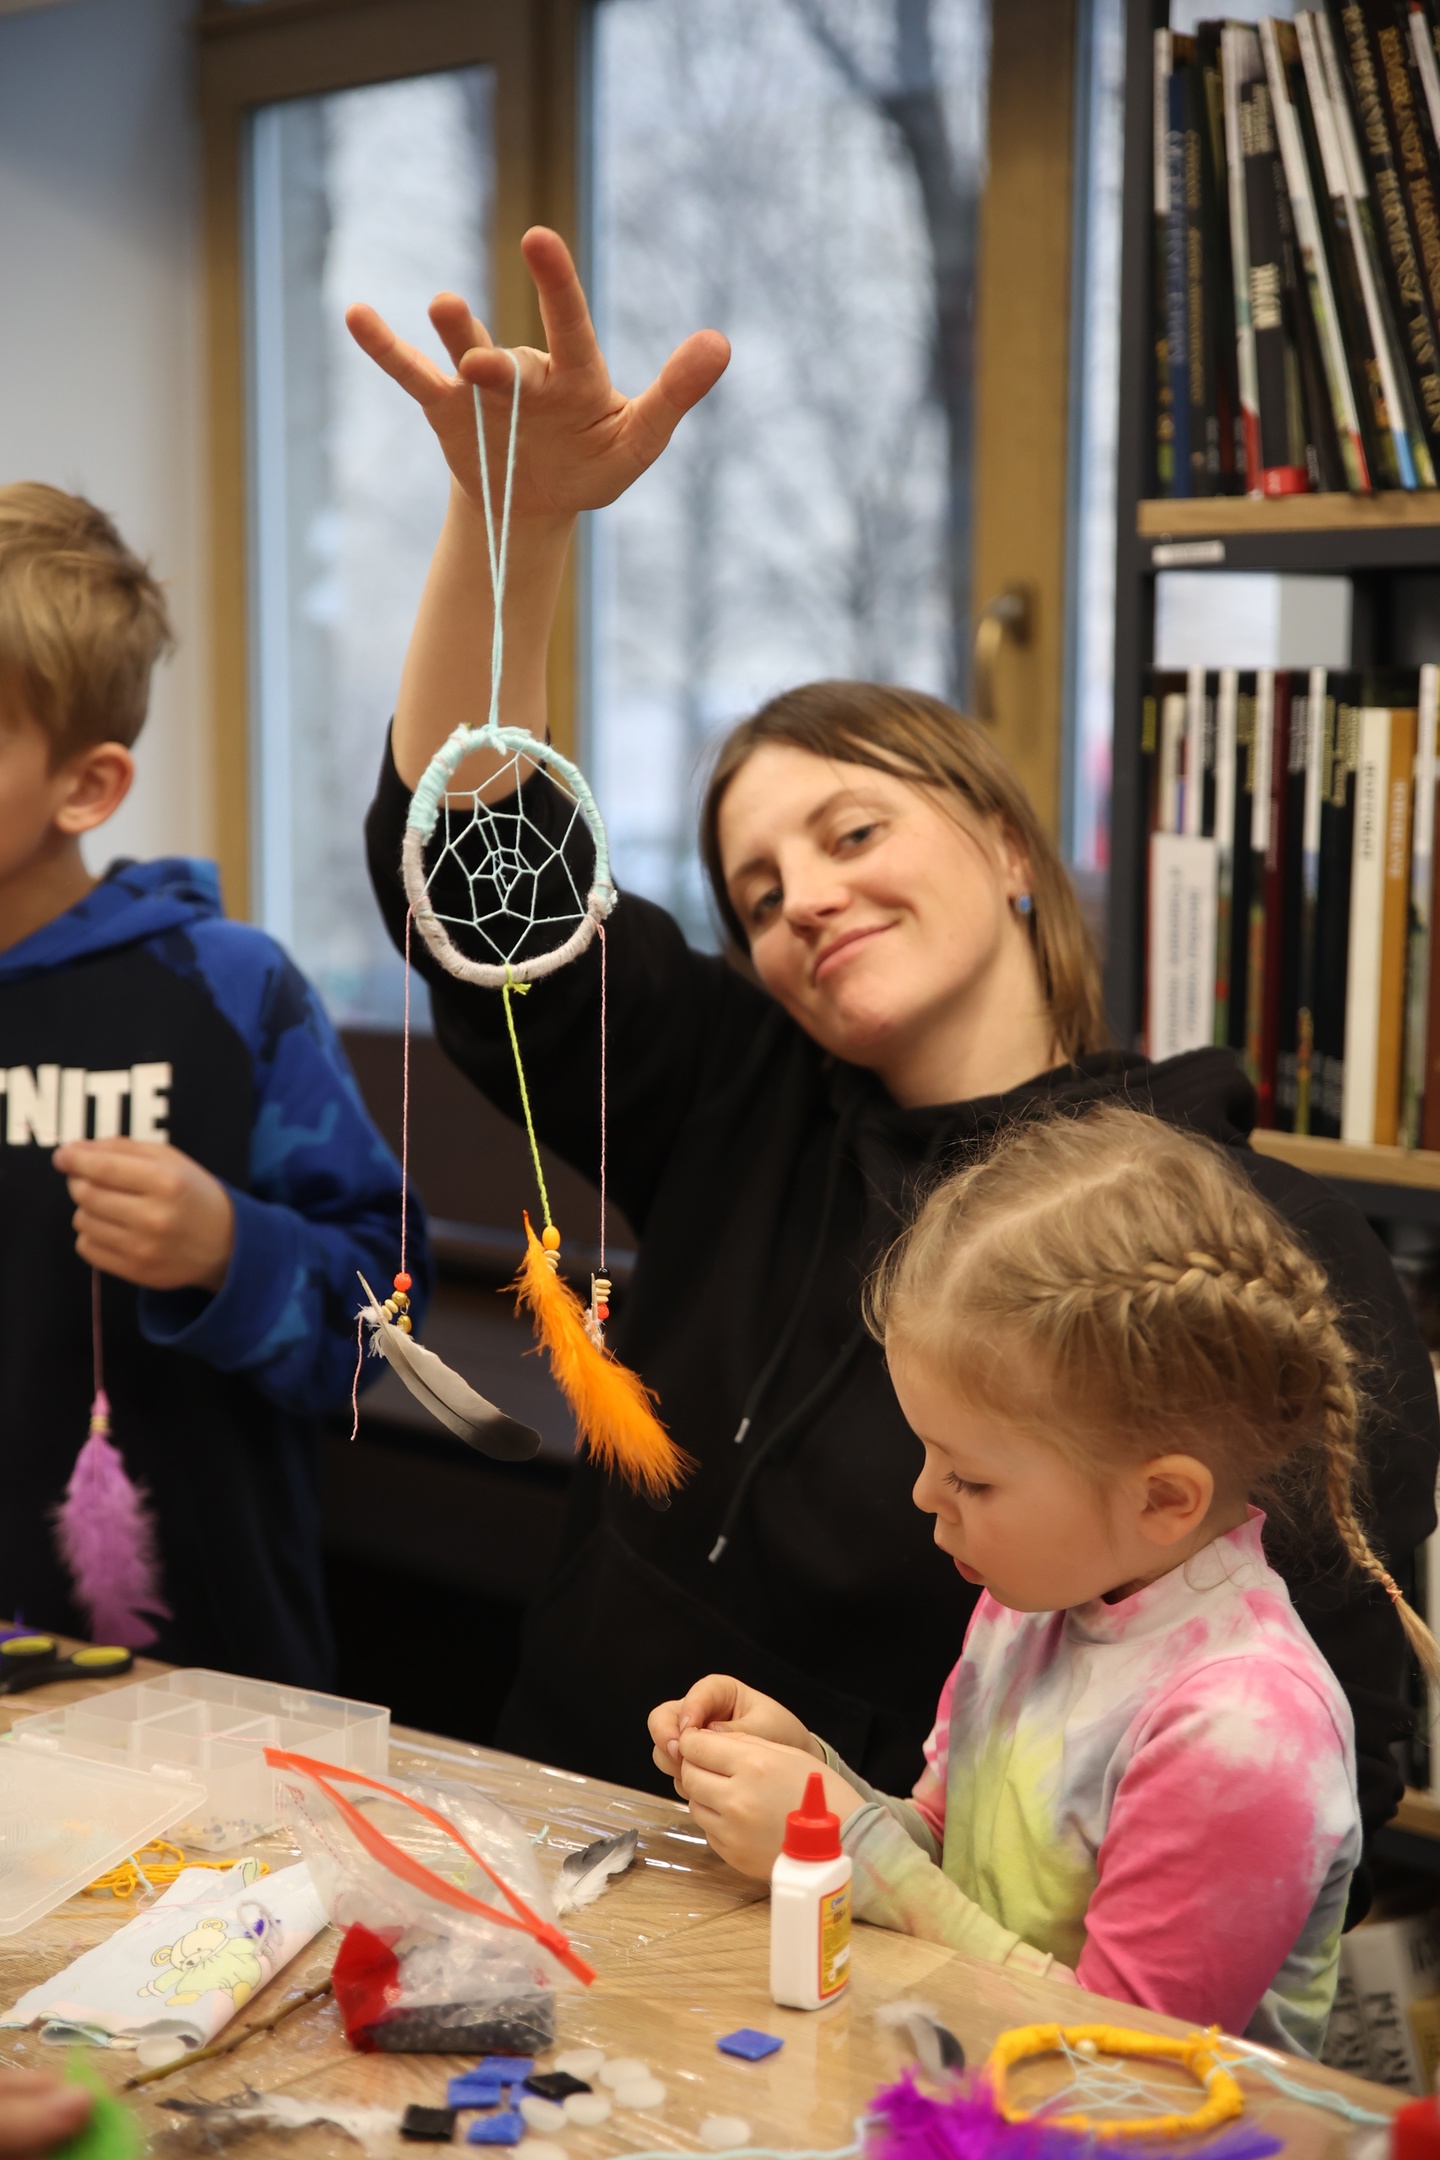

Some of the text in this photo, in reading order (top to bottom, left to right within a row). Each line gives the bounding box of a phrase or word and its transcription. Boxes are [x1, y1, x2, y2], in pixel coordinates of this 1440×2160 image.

[1341, 4, 1392, 155] REMBRANDT
[1378, 25, 1428, 172] REMBRANDT
[0, 1062, 172, 1147] NITE
